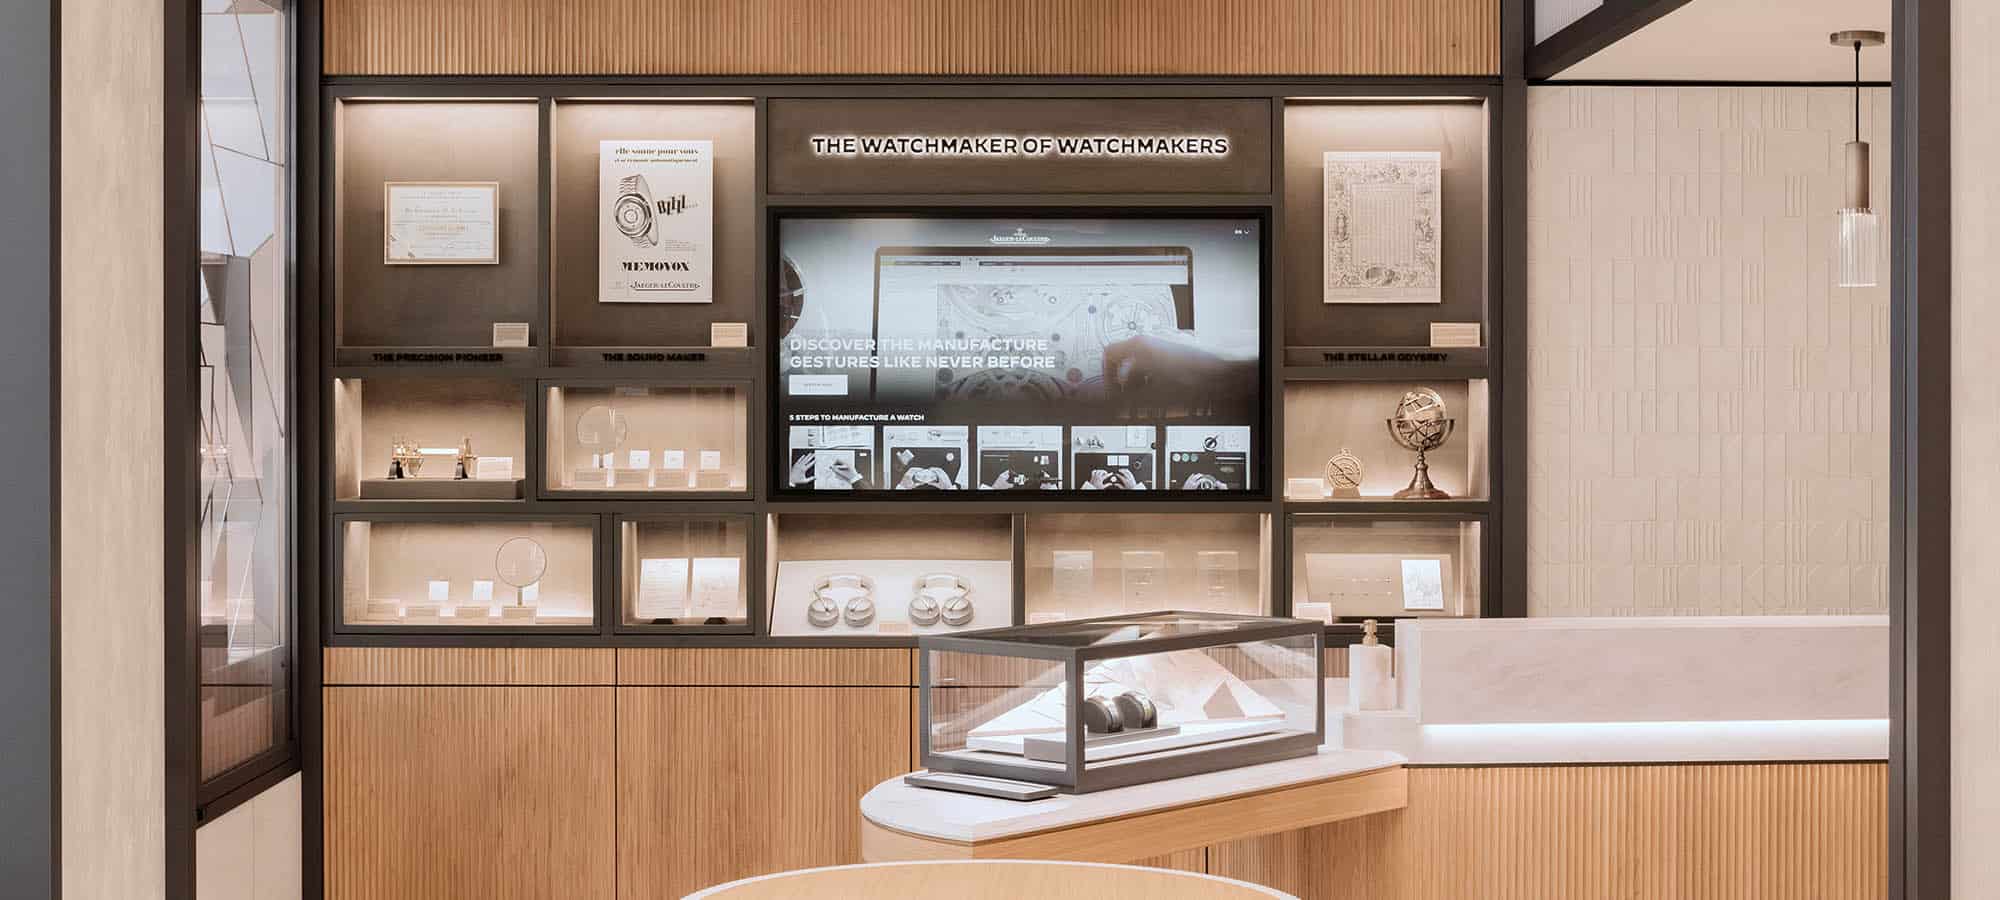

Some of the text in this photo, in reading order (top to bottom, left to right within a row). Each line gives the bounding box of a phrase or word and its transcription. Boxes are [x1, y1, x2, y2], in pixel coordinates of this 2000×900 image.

[812, 138, 1228, 153] THE WATCHMAKER OF WATCHMAKERS
[622, 261, 690, 272] MEMOVOX
[790, 338, 1049, 351] DISCOVER THE MANUFACTURE
[372, 352, 503, 362] THE PRECISION PIONEER
[602, 352, 705, 362] THE SOUND MAKER
[790, 356, 1057, 369] GESTURES LIKE NEVER BEFORE
[1323, 352, 1345, 362] THE
[1347, 352, 1395, 362] STELLAR
